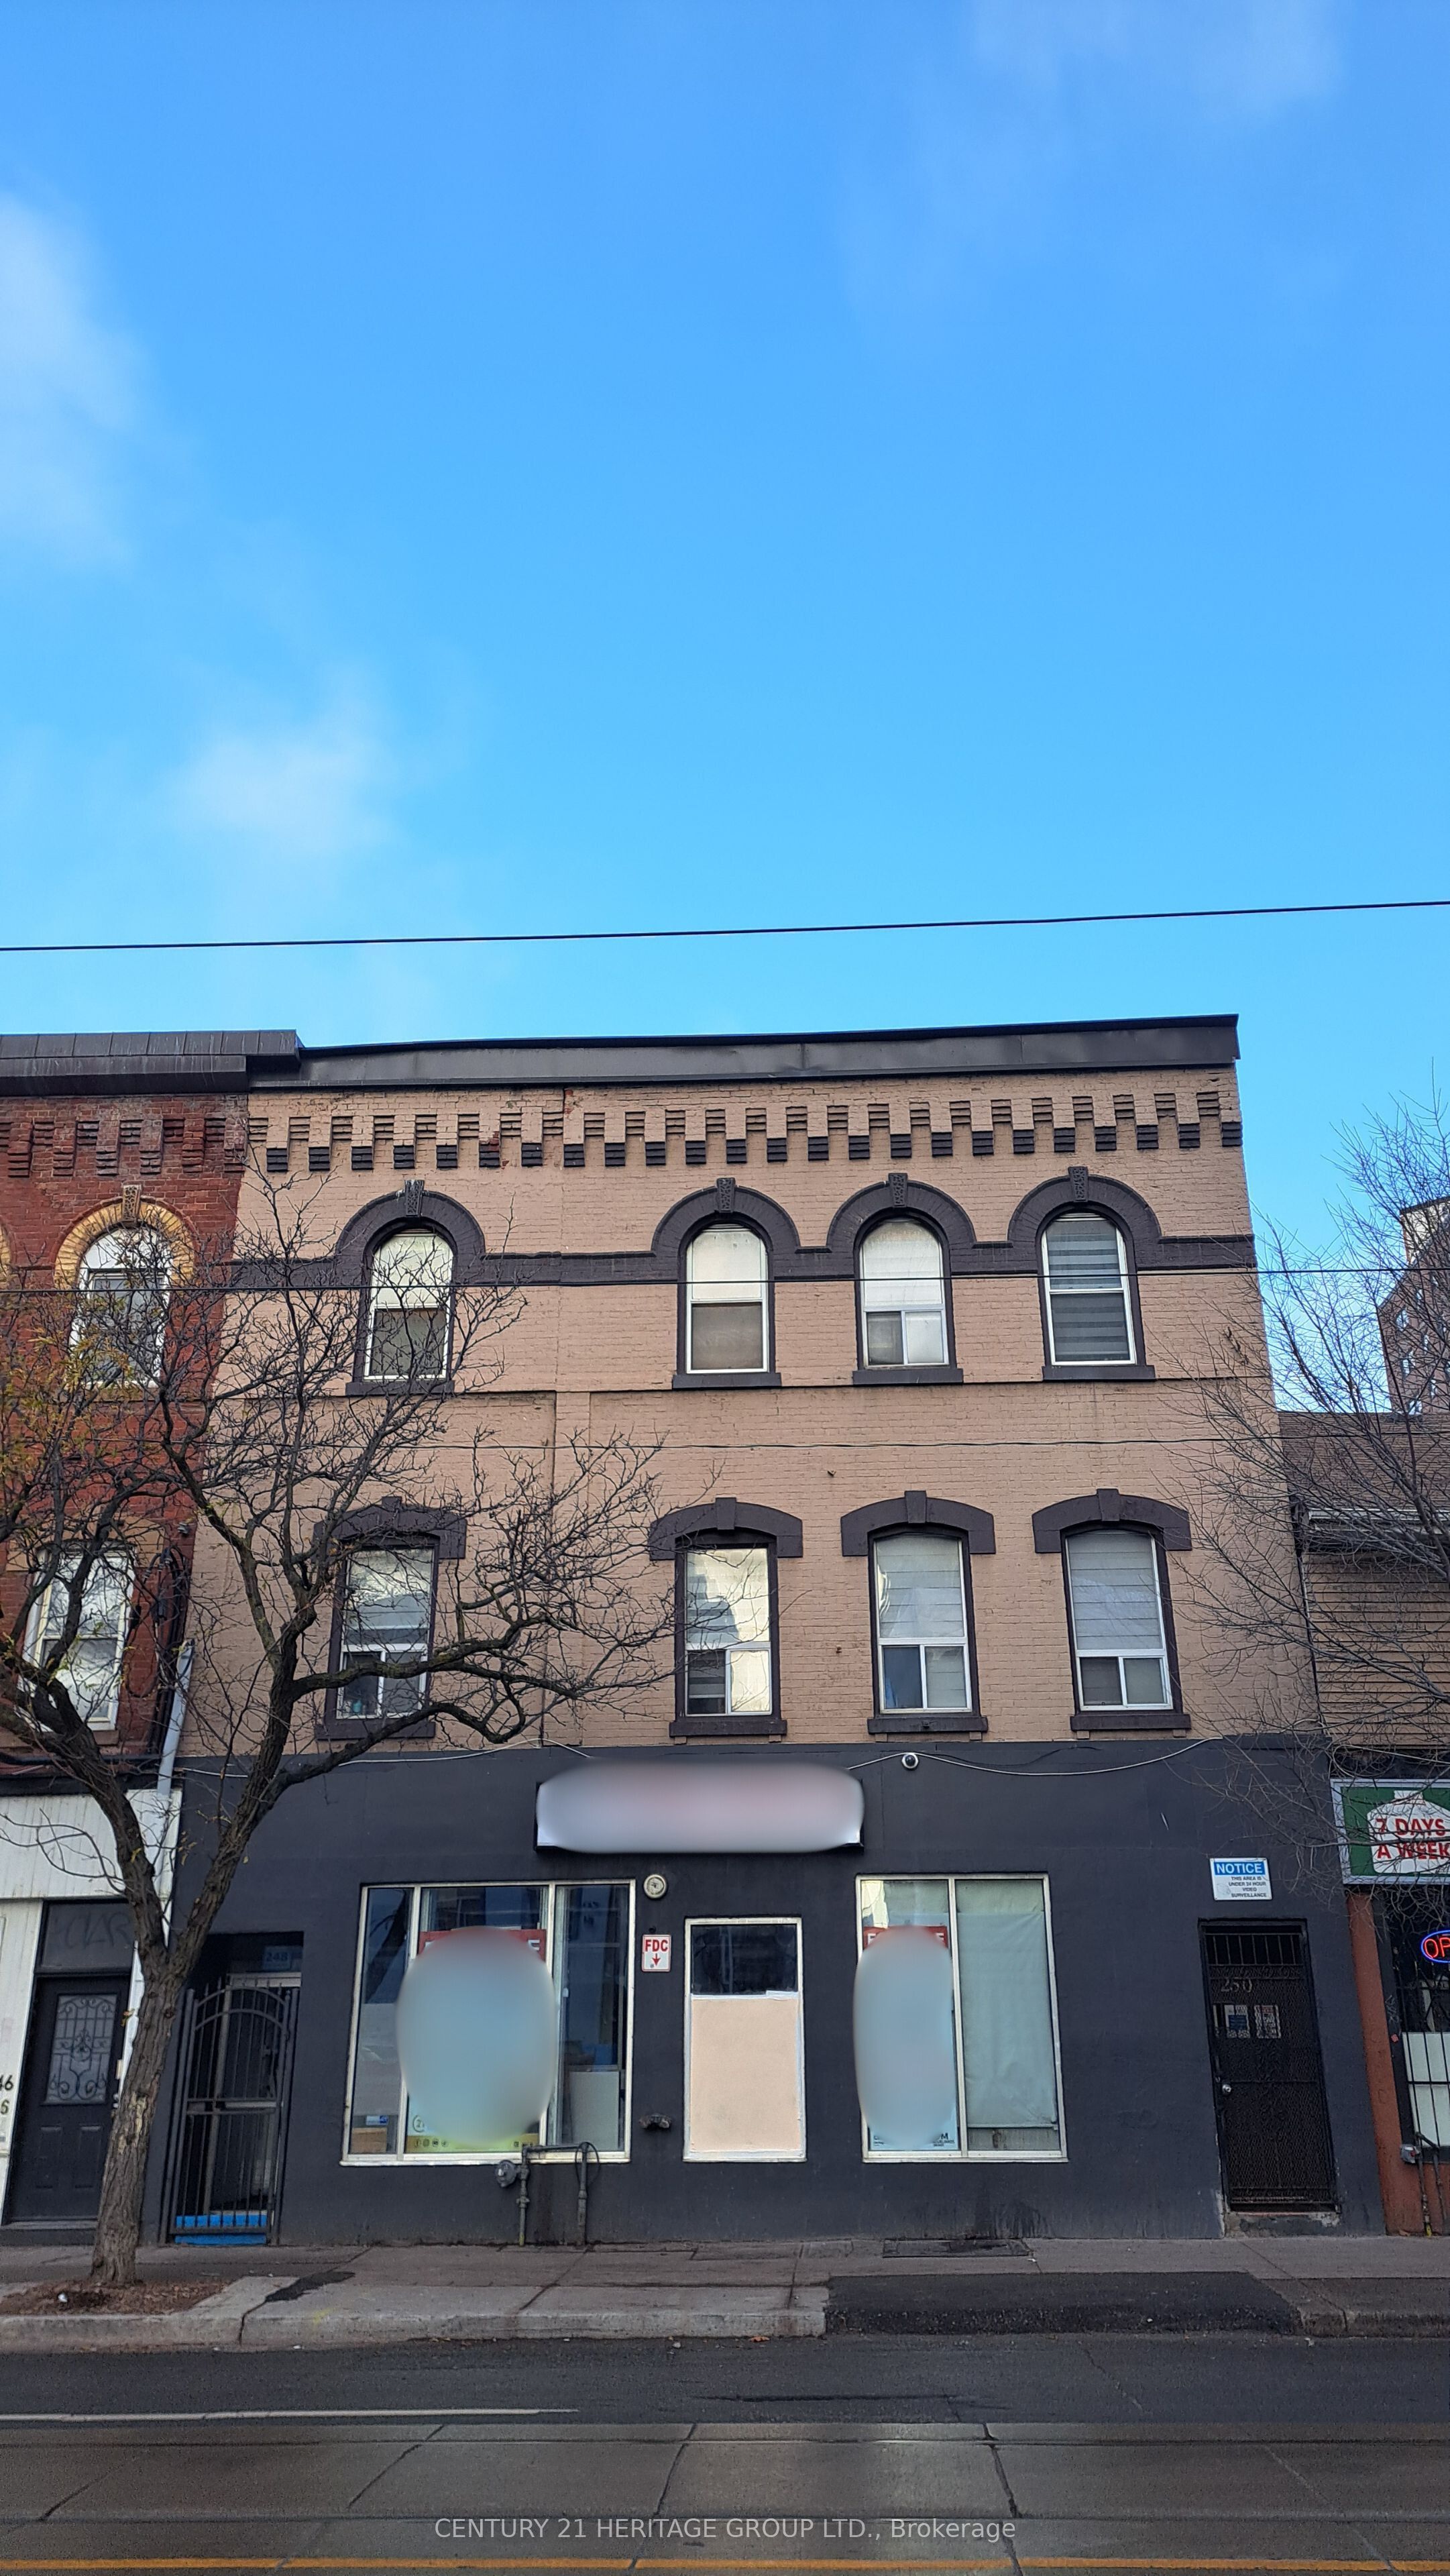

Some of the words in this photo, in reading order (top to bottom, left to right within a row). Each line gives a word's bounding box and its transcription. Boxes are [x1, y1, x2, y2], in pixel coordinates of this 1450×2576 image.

[1375, 1817, 1388, 1835] 7
[1395, 1817, 1446, 1836] DAYS
[1376, 1841, 1392, 1859] A
[1396, 1841, 1450, 1860] WEEK
[1216, 1863, 1263, 1874] NOTICE
[645, 1939, 669, 1952] FDC
[1424, 1937, 1450, 1959] OP
[1221, 1978, 1253, 1993] 250
